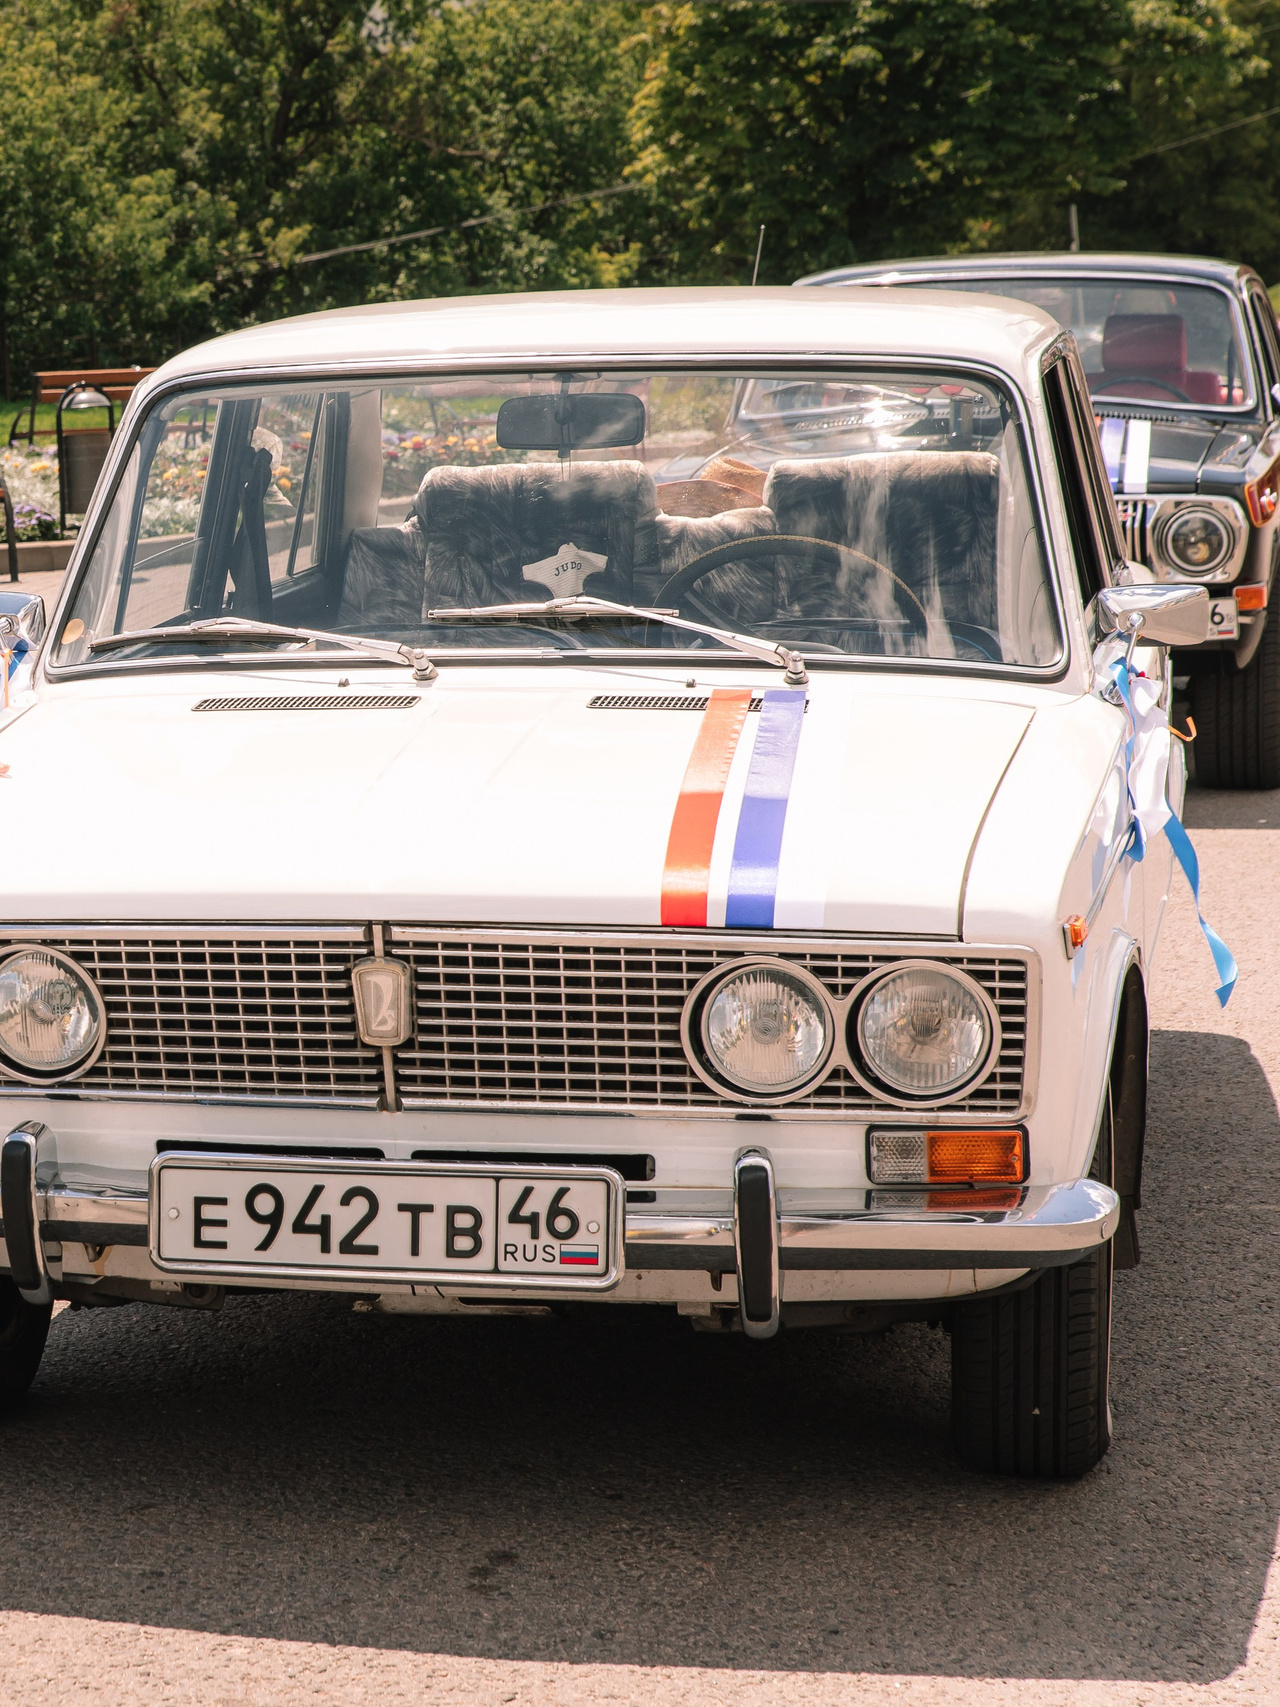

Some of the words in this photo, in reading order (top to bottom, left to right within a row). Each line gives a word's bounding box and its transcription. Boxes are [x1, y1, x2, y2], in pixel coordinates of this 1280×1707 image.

[554, 560, 582, 577] JUDO
[507, 1185, 580, 1241] 46
[503, 1243, 556, 1263] RUS
